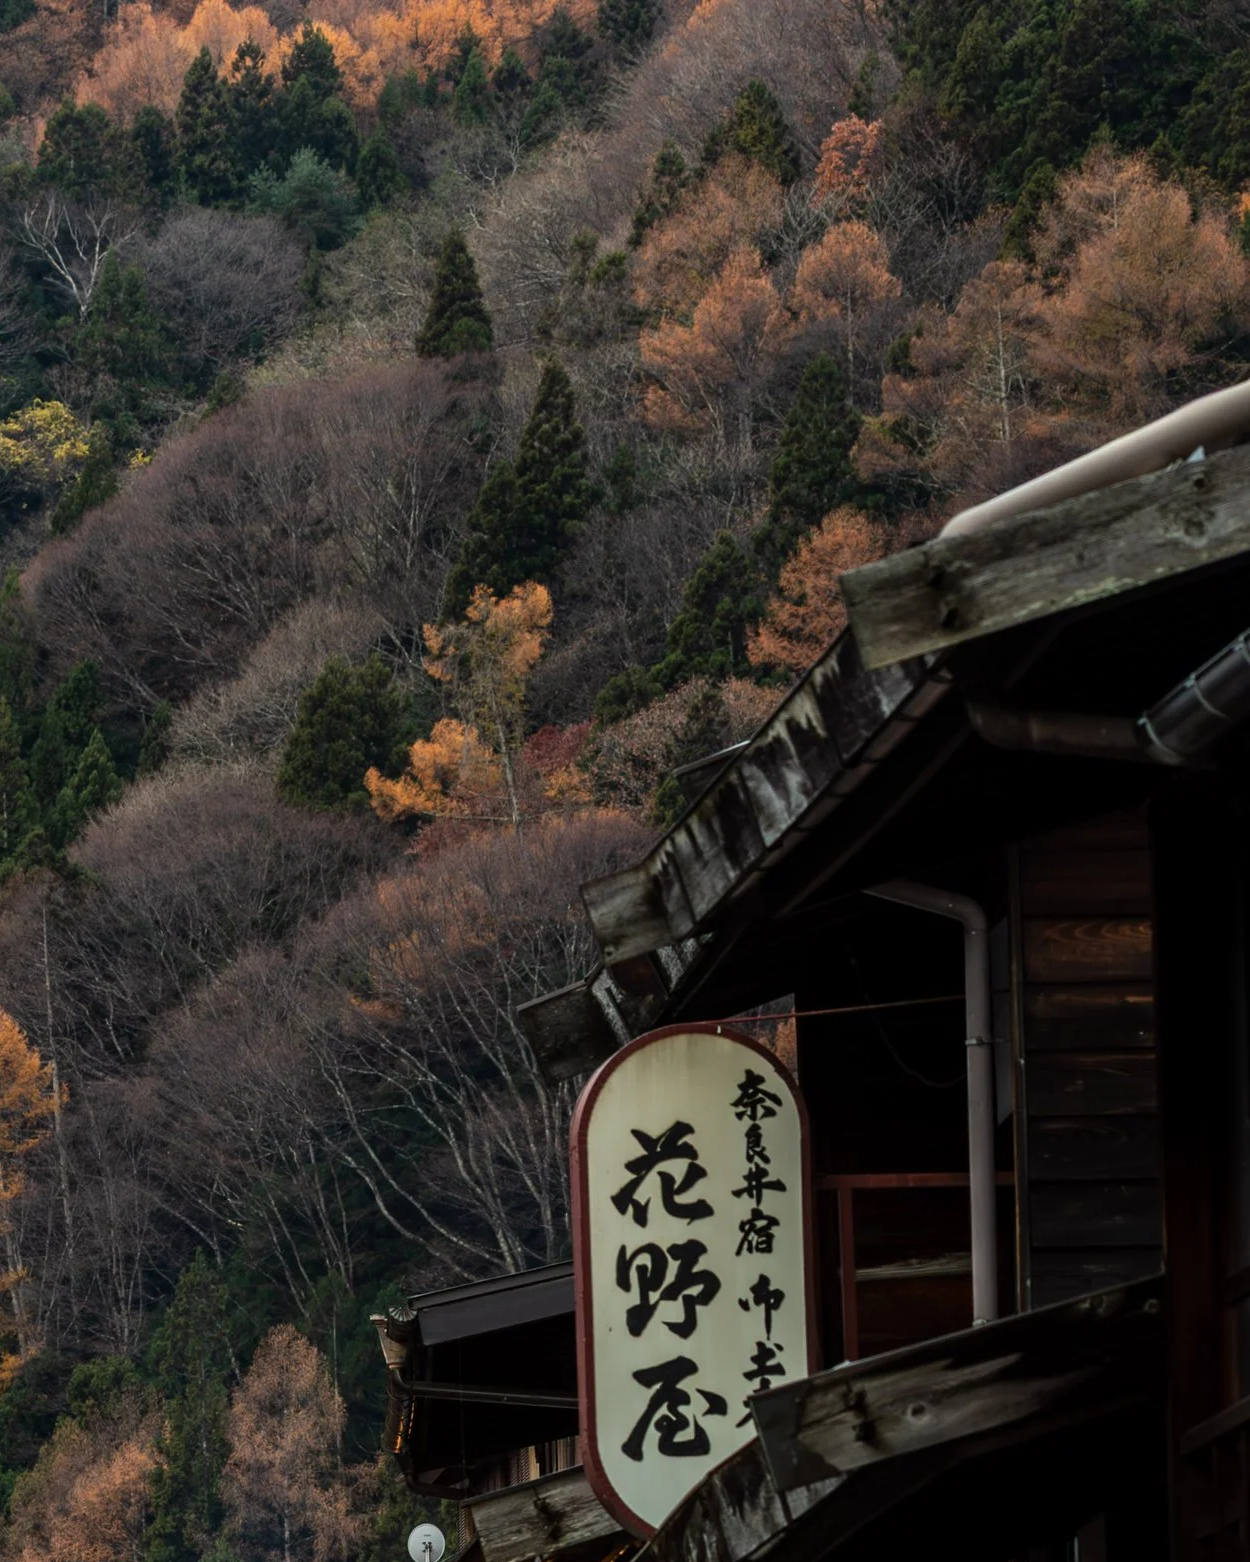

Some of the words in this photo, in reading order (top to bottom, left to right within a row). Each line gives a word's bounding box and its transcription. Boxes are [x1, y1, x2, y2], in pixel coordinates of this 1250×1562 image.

[610, 1120, 729, 1461] 花野屋
[729, 1069, 787, 1256] 奈良井宿
